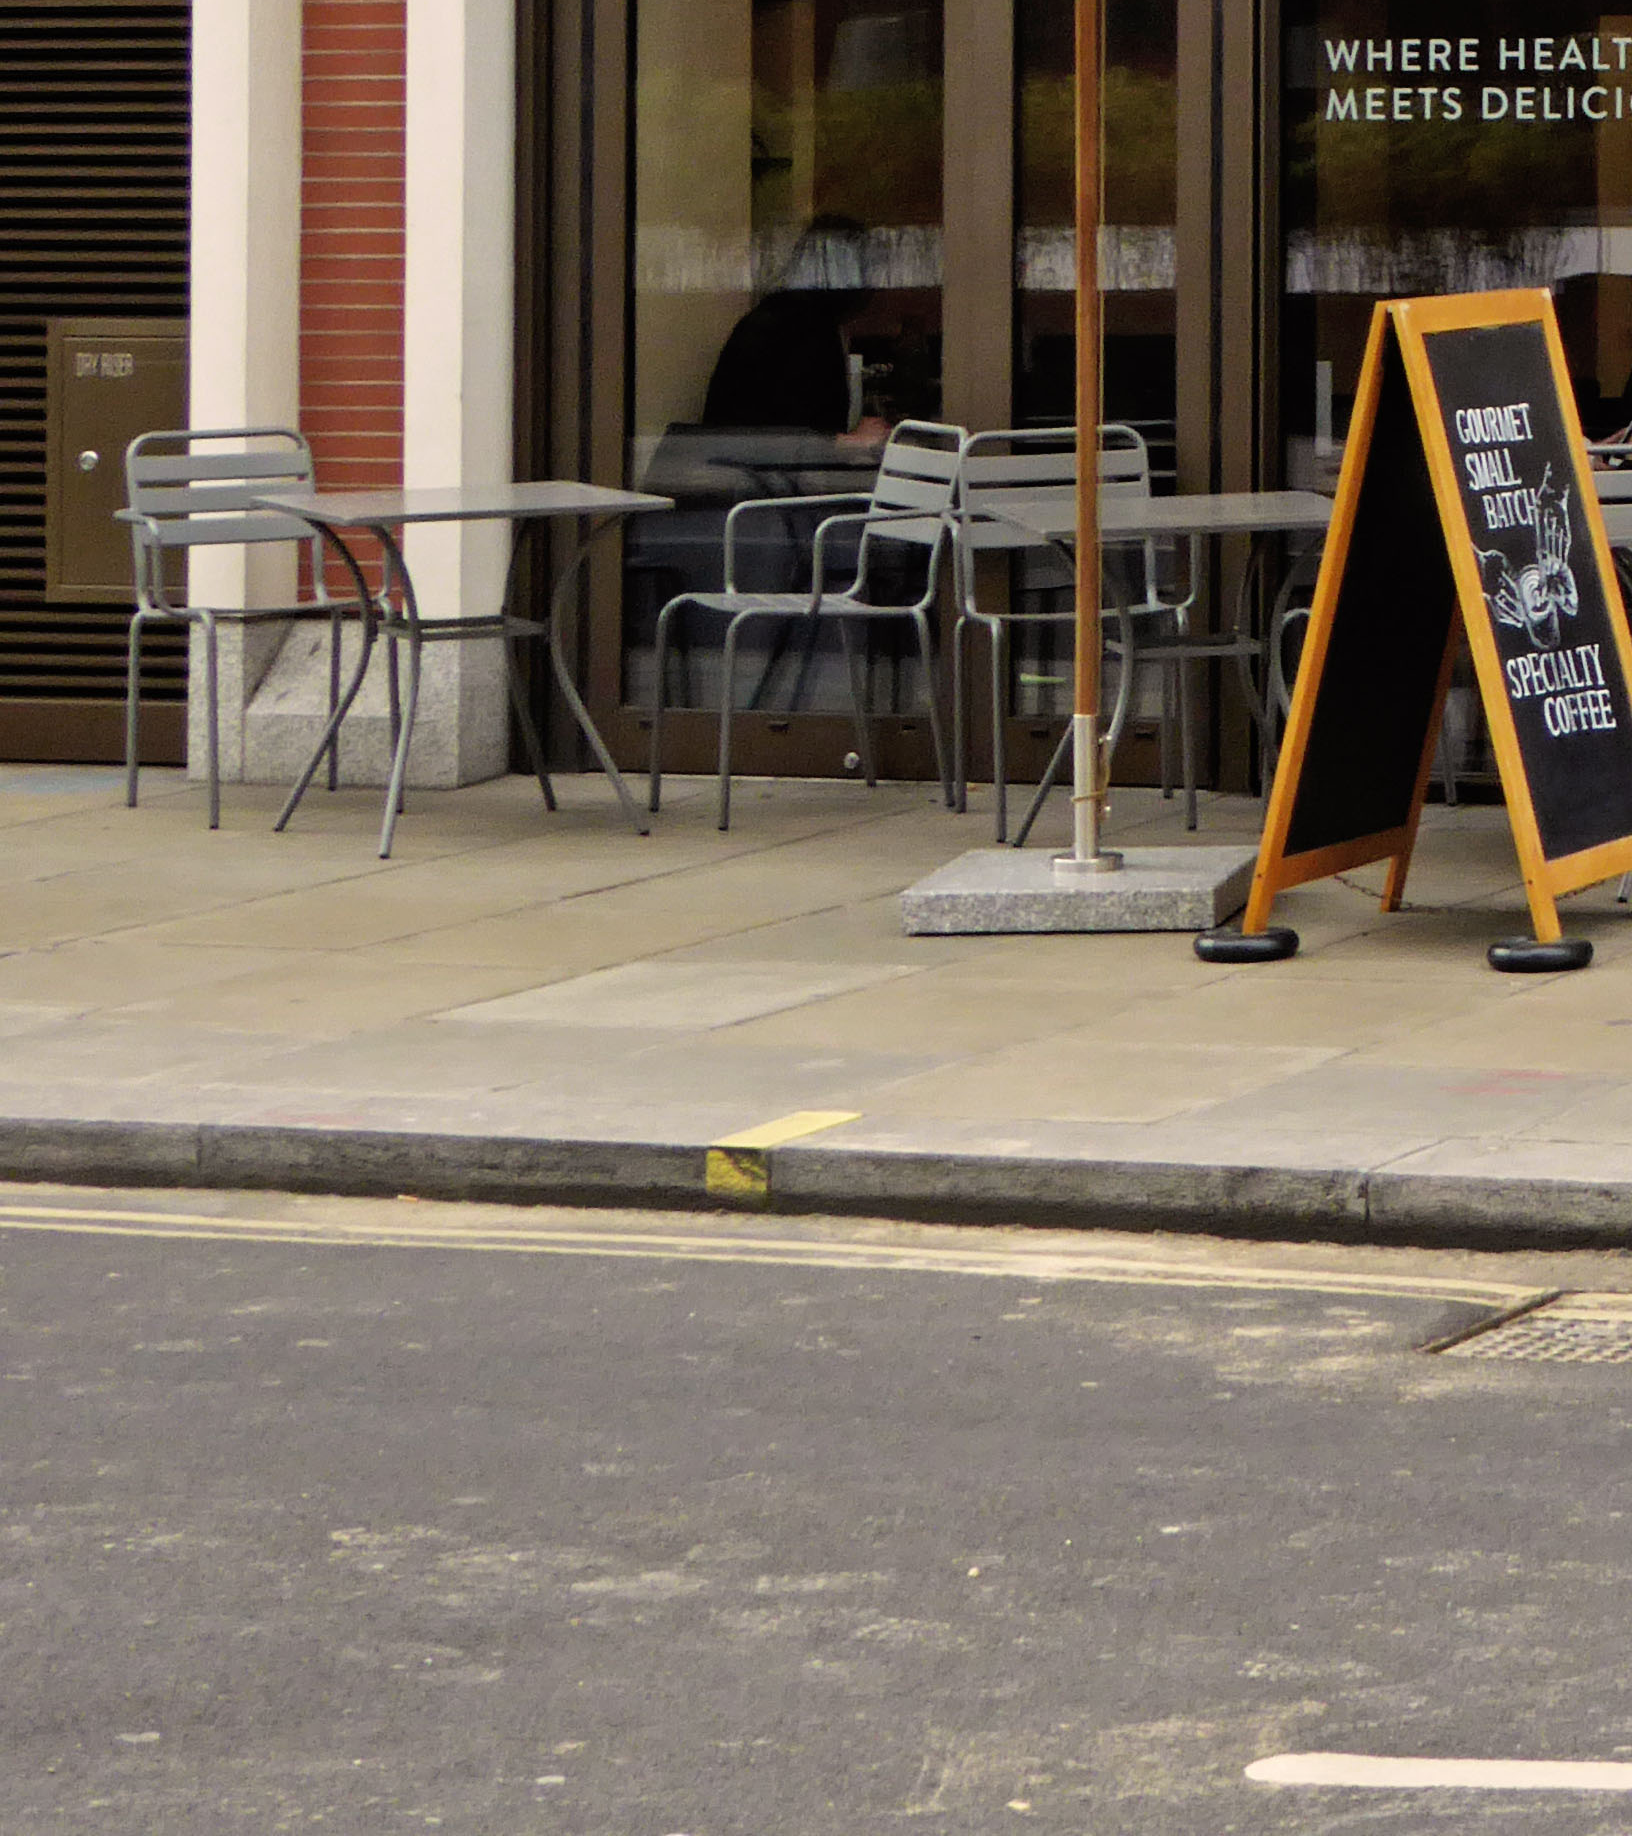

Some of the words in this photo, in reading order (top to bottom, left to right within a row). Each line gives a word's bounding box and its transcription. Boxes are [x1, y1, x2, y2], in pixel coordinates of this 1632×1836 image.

[1324, 37, 1481, 73] WHERE
[1325, 86, 1463, 121] MEETS
[1455, 402, 1534, 445] GOURMET
[1464, 447, 1523, 492] SMALL
[1481, 487, 1539, 530] BATCH
[1505, 643, 1606, 700] SPECIALTY
[1543, 688, 1617, 738] COFFEE
